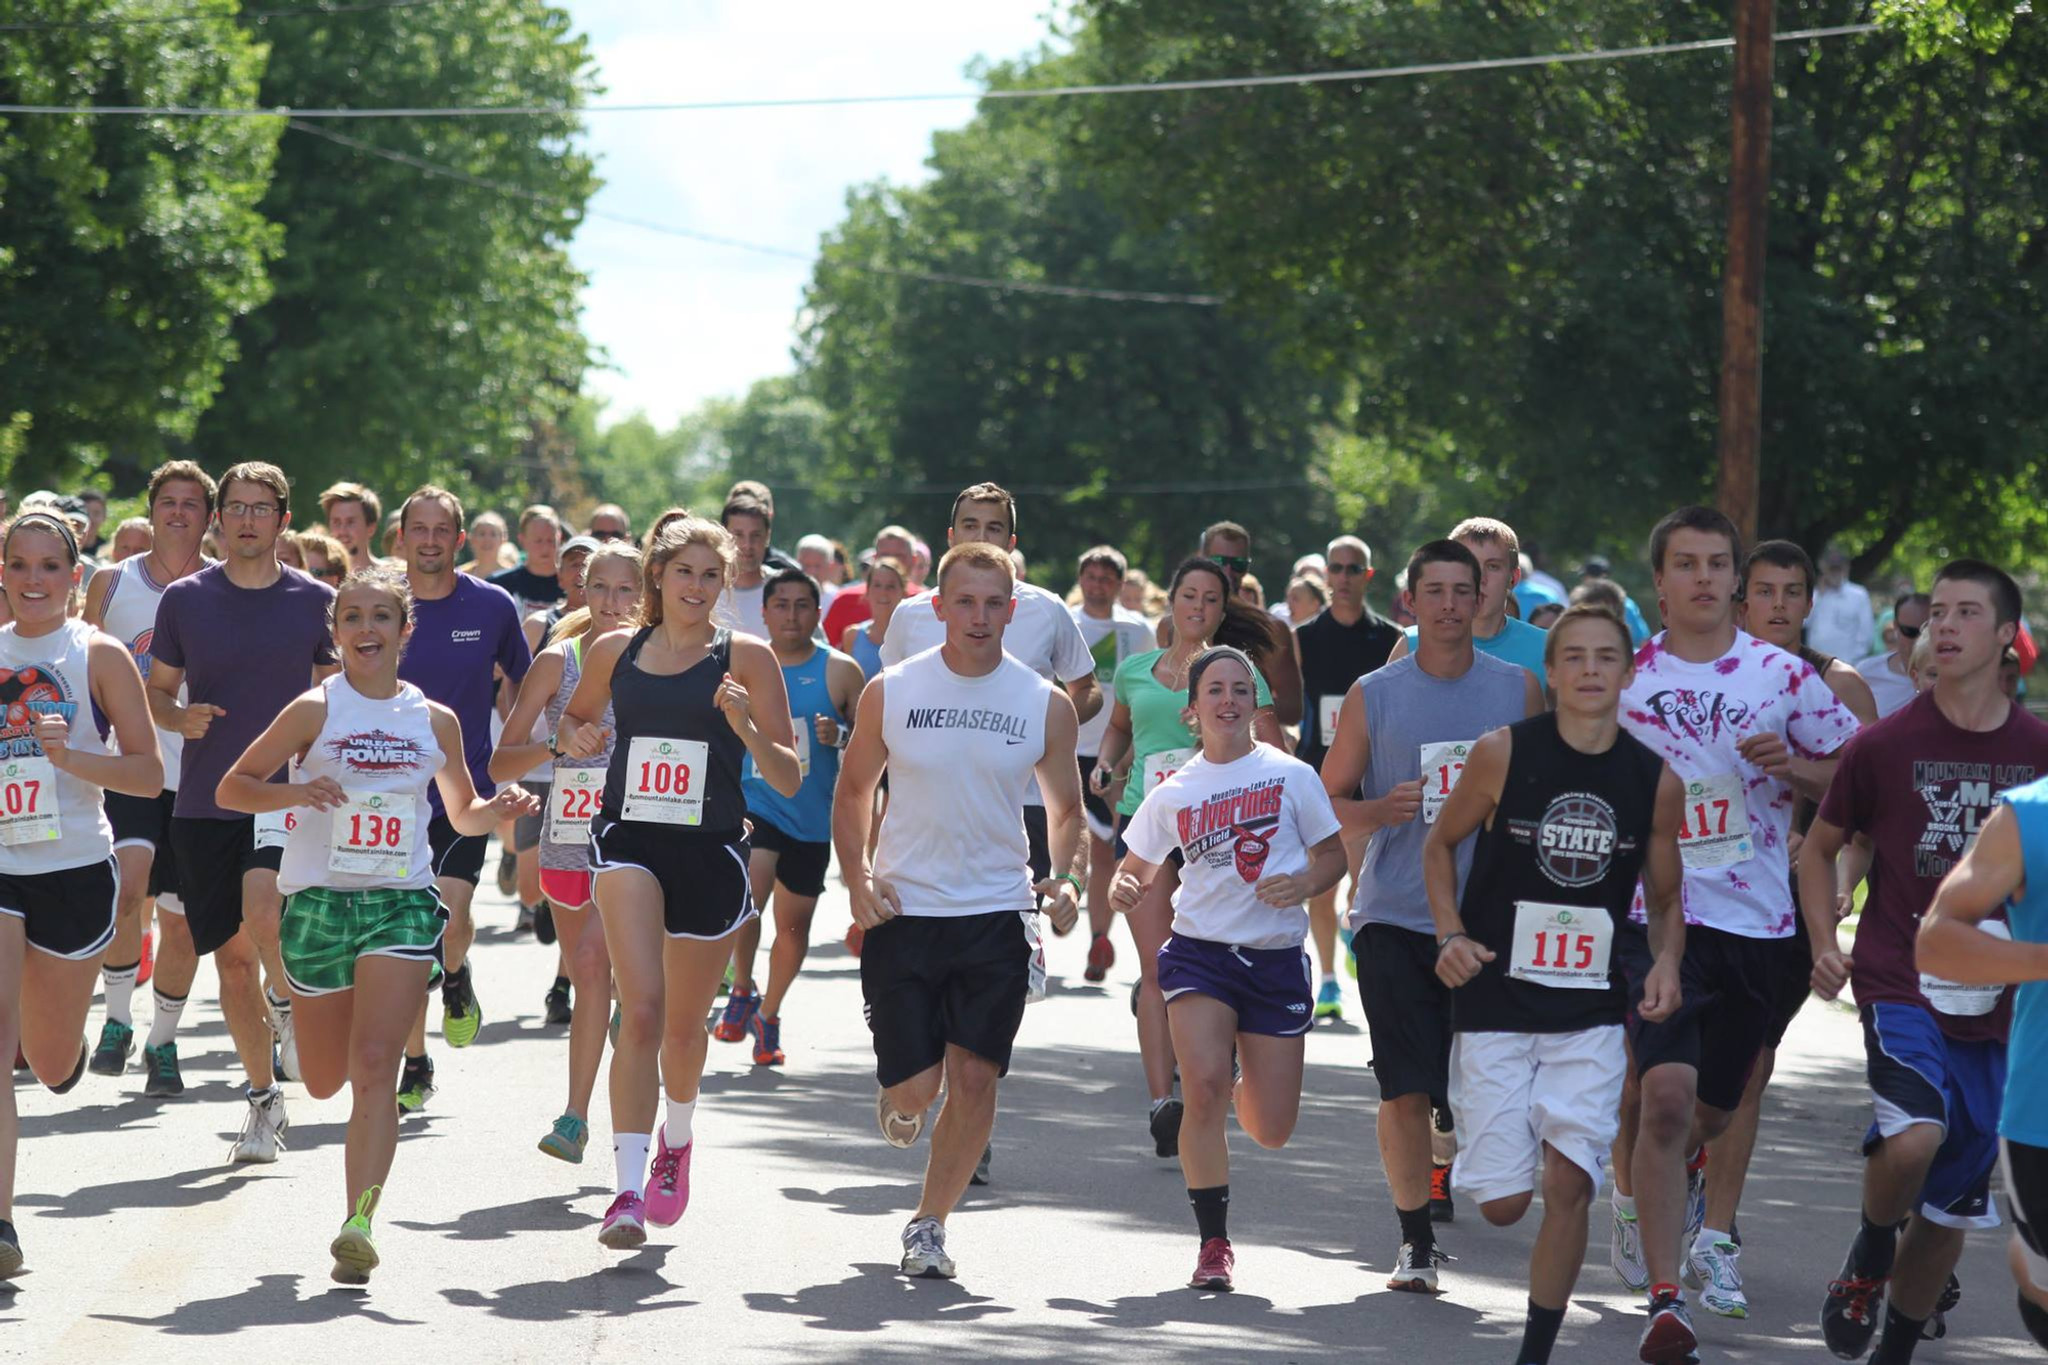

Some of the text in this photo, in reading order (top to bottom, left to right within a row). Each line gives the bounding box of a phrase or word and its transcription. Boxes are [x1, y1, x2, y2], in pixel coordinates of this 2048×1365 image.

[451, 630, 481, 638] Crown
[340, 748, 417, 763] POWER
[349, 738, 408, 748] UNLEASH
[638, 761, 691, 795] 108
[1211, 777, 1286, 803] Mountain Lake Area
[1913, 761, 2035, 792] MOUNTAIN LAKE
[0, 780, 40, 816] 07
[1960, 781, 1990, 807] M
[1177, 783, 1285, 847] Wolverines
[1927, 822, 1960, 833] BROOKE
[348, 814, 402, 847] 138
[1201, 838, 1209, 851] &
[1209, 828, 1230, 847] Field
[1541, 824, 1614, 854] STATE
[1532, 931, 1594, 969] 115
